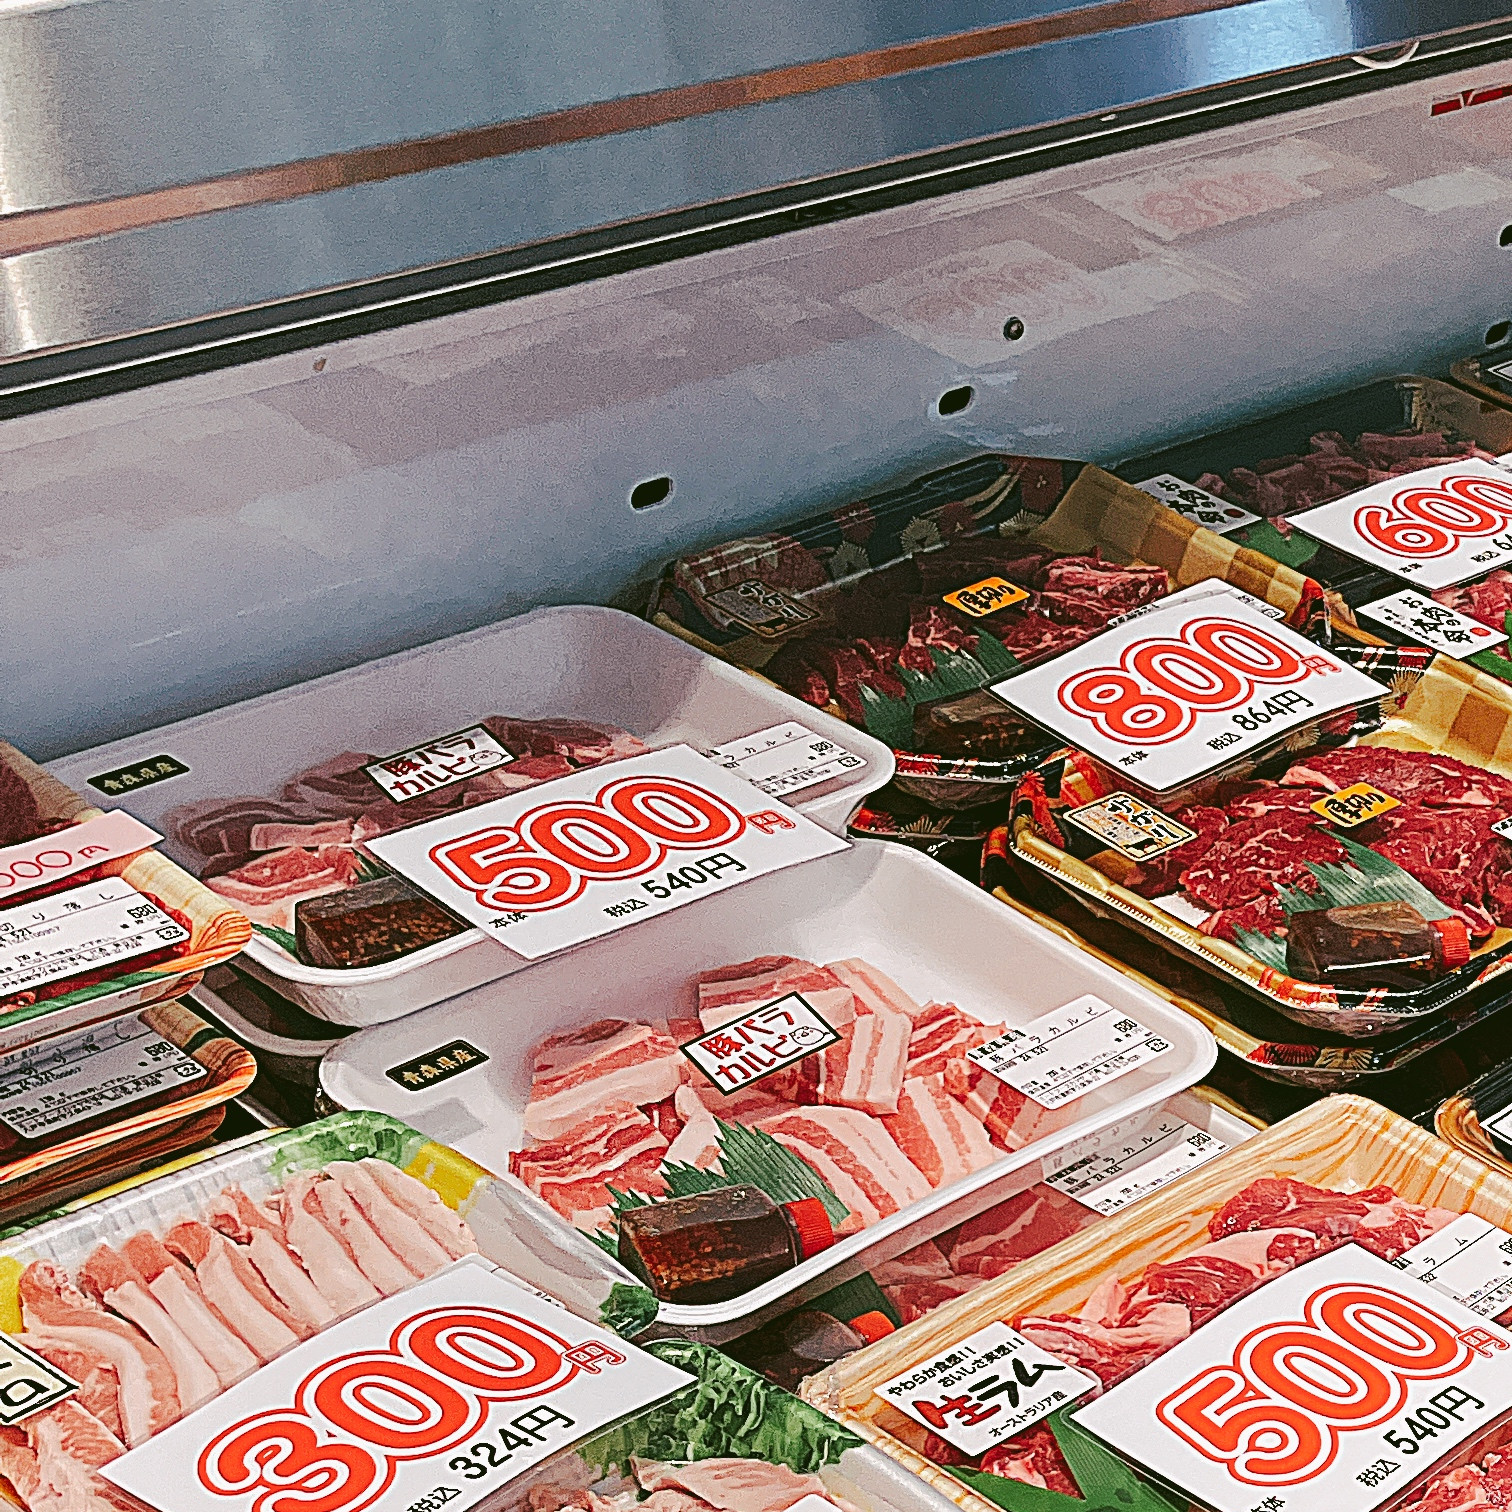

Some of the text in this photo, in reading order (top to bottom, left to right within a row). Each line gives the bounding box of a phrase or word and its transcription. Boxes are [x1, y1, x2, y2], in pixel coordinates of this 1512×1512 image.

[1058, 616, 1343, 746] 800円
[1232, 689, 1315, 732] 864円
[379, 735, 478, 778] 豚バラ
[389, 757, 479, 796] カルビ
[428, 775, 797, 913] 500円
[640, 851, 747, 900] 540円
[699, 1007, 795, 1060] 豚バラ
[402, 1048, 479, 1086] 青森県産
[715, 1034, 801, 1087] カルビ
[911, 1357, 1067, 1430] 生ラム
[1155, 1282, 1510, 1486] 500円
[988, 1390, 1069, 1438] オーストラリア産
[1355, 1385, 1486, 1489] 税込 540円
[449, 1404, 580, 1486] 324円
